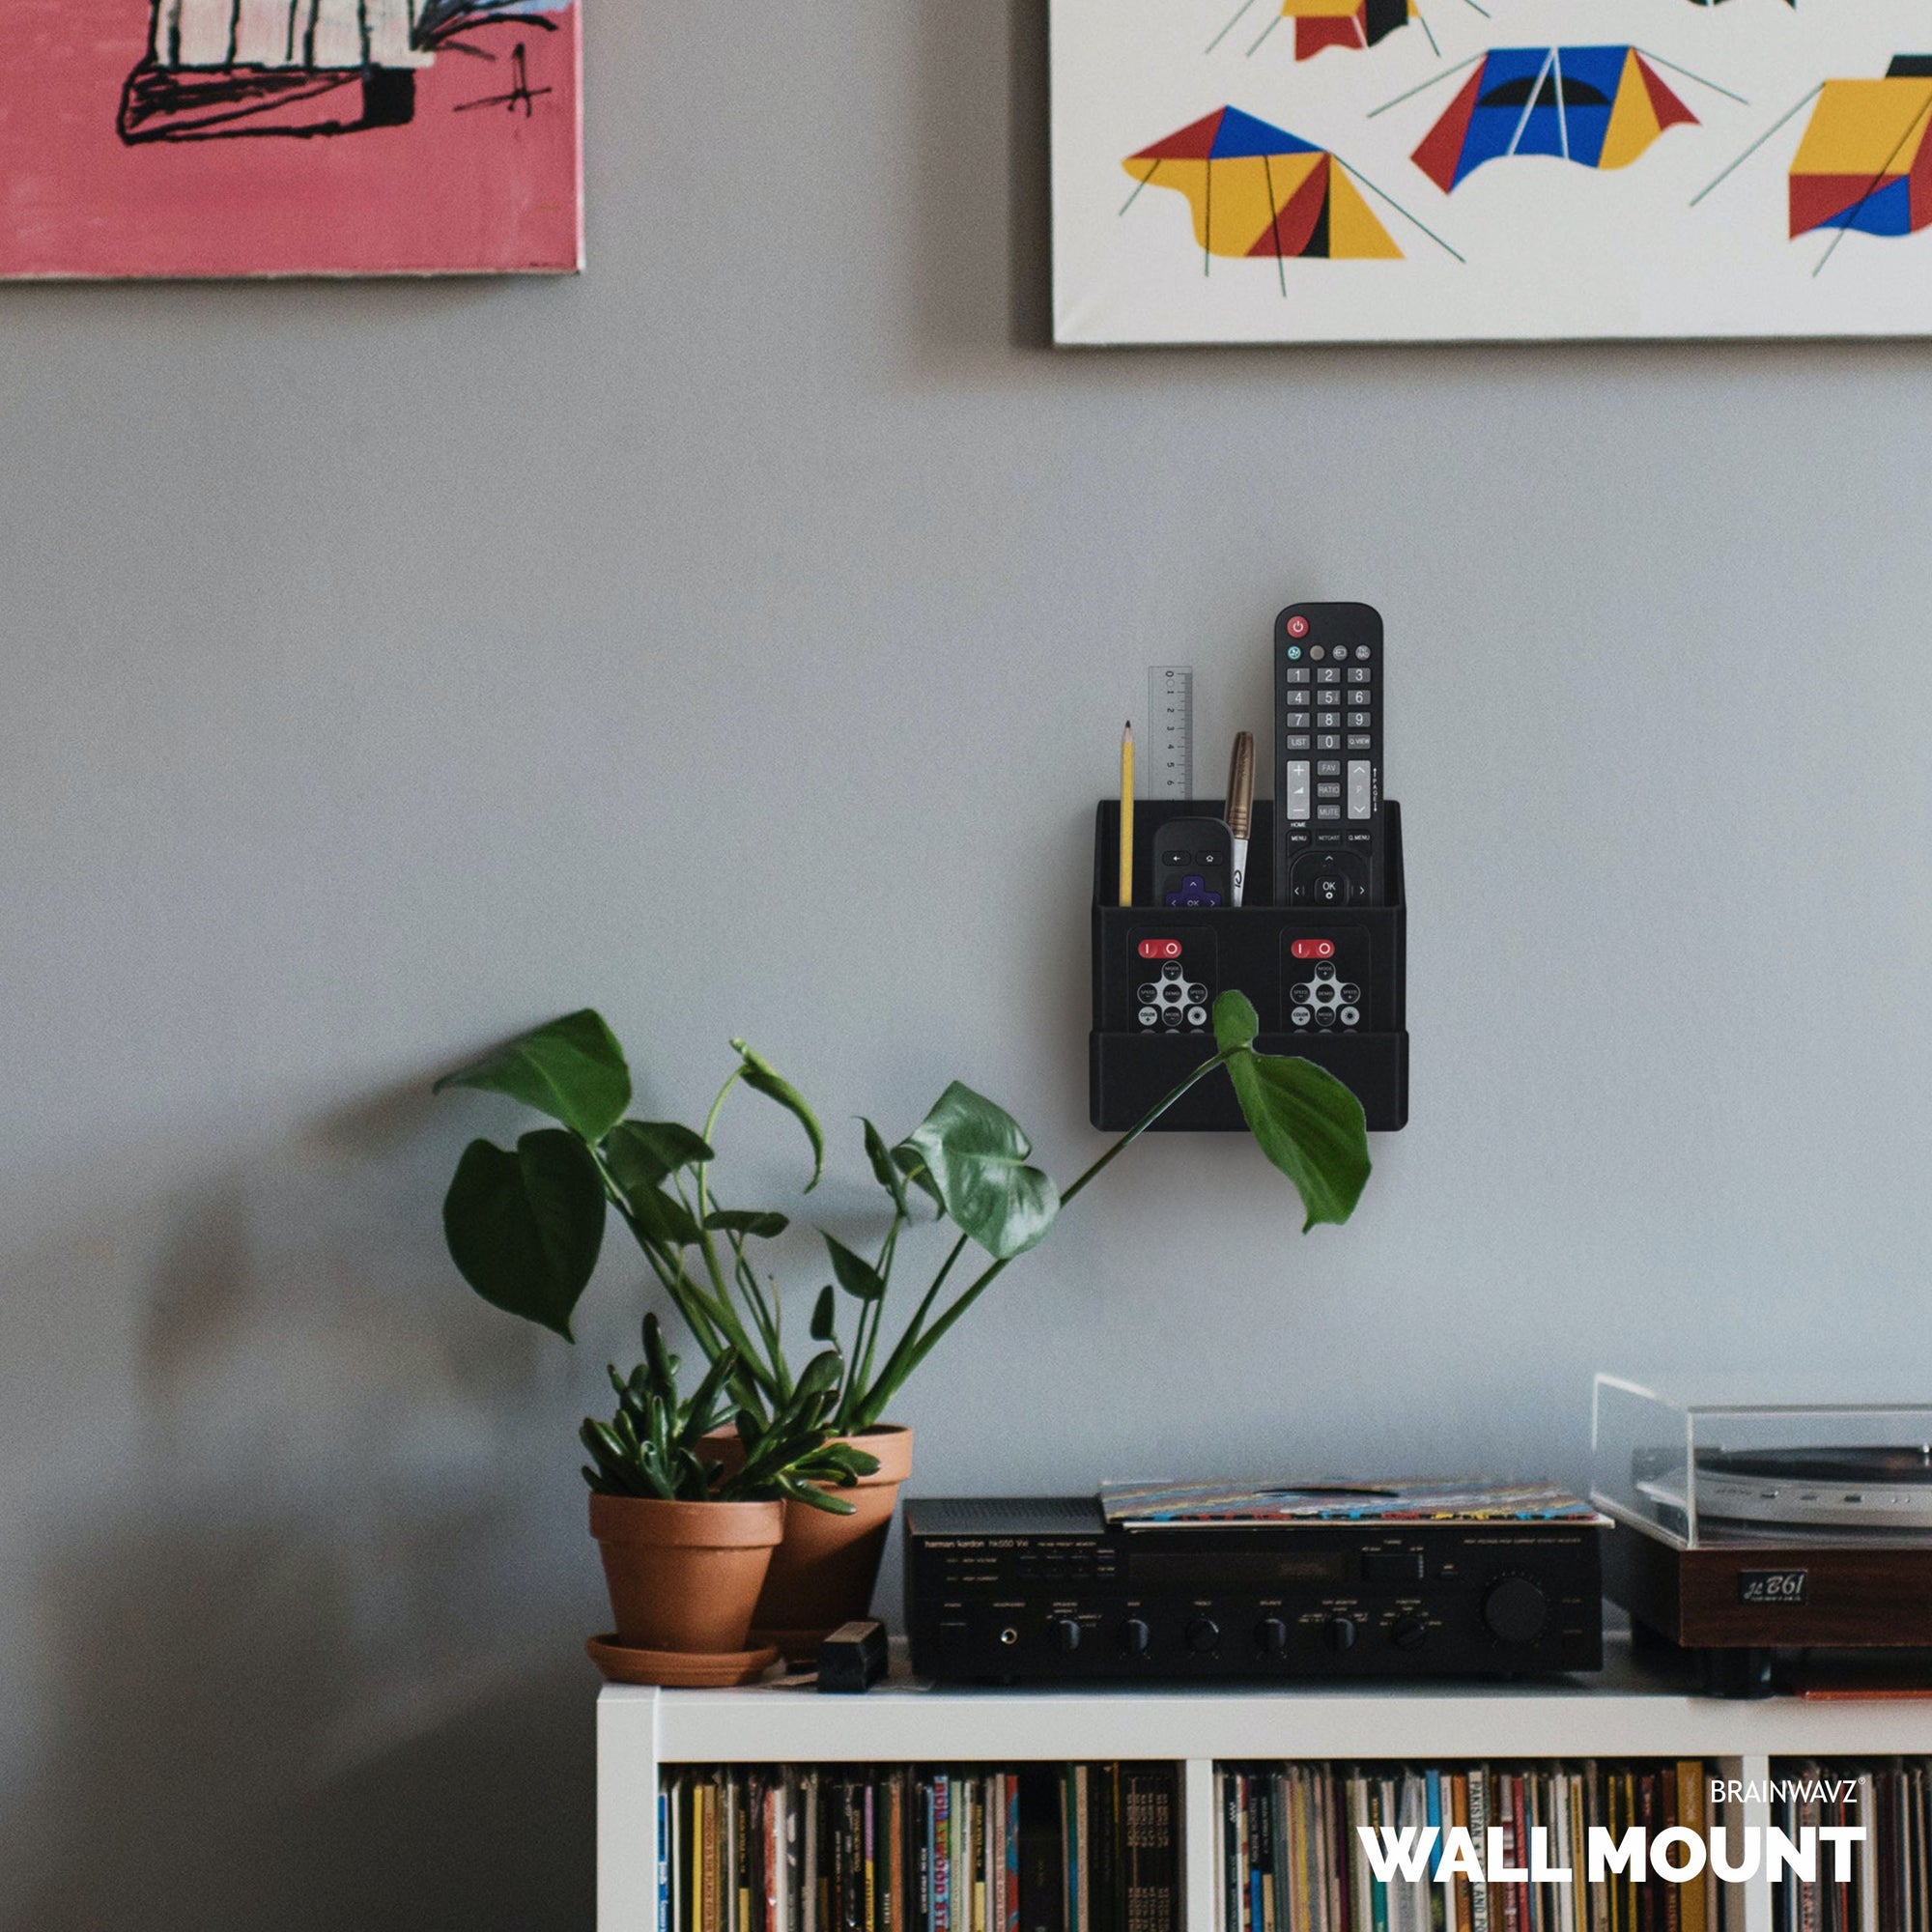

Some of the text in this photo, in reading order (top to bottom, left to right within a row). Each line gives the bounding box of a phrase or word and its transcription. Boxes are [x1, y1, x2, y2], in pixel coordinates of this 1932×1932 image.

[1295, 668, 1301, 681] 1
[1324, 668, 1333, 682] 2
[1355, 668, 1363, 681] 3
[1294, 692, 1302, 704] 4
[1324, 691, 1333, 704] 5
[1355, 691, 1363, 703] 6
[1294, 714, 1302, 726] 7
[1324, 713, 1333, 726] 8
[1355, 712, 1363, 725] 9
[1324, 735, 1333, 749] 0
[1319, 808, 1340, 816] MUTE
[1322, 881, 1336, 891] OK
[1469, 1780, 1484, 1837] PAKISTAN
[934, 1782, 947, 1896] BOLLYWOOD
[1473, 1889, 1487, 1914] AND
